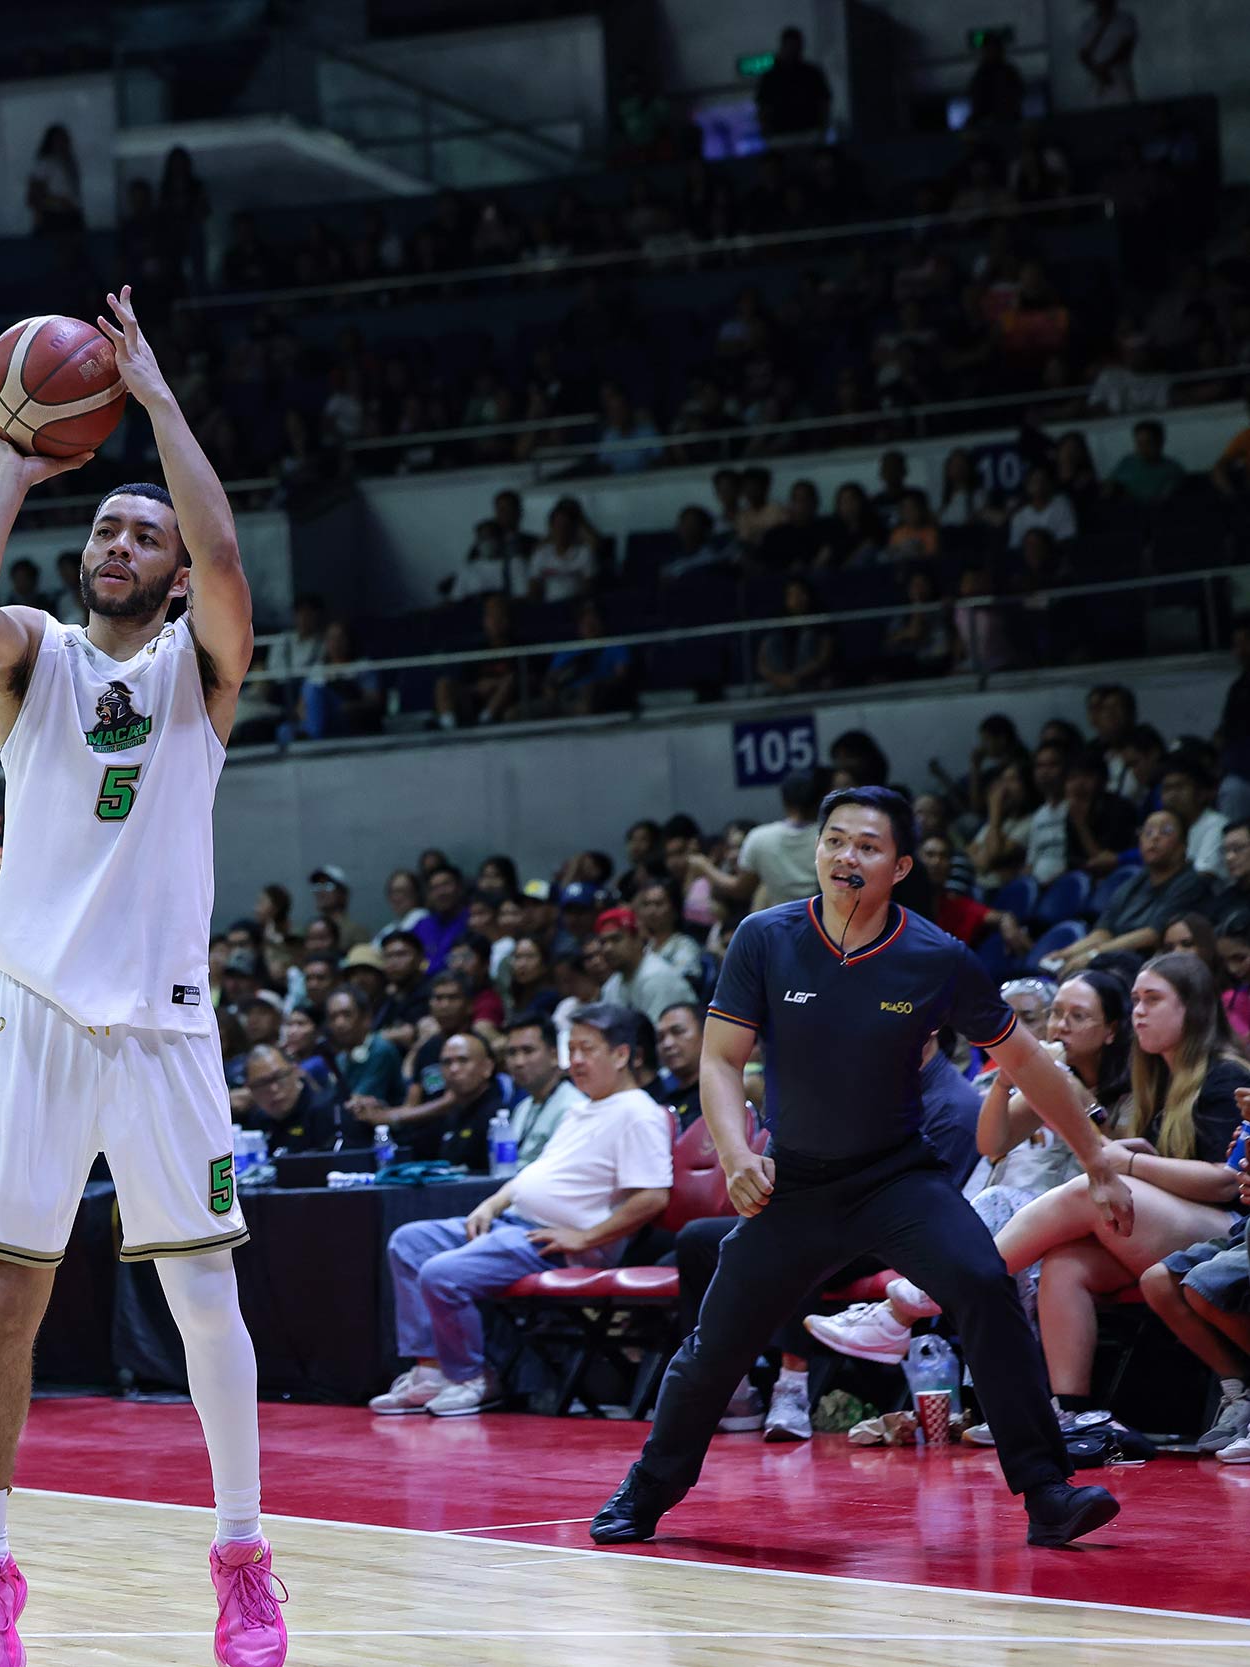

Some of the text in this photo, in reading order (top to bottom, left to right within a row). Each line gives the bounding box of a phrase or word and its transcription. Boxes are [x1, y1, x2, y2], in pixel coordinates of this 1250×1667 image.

[977, 452, 1030, 489] 10
[87, 719, 150, 745] MACAU
[737, 727, 813, 775] 105
[94, 764, 142, 822] 5
[208, 1151, 234, 1217] 5
